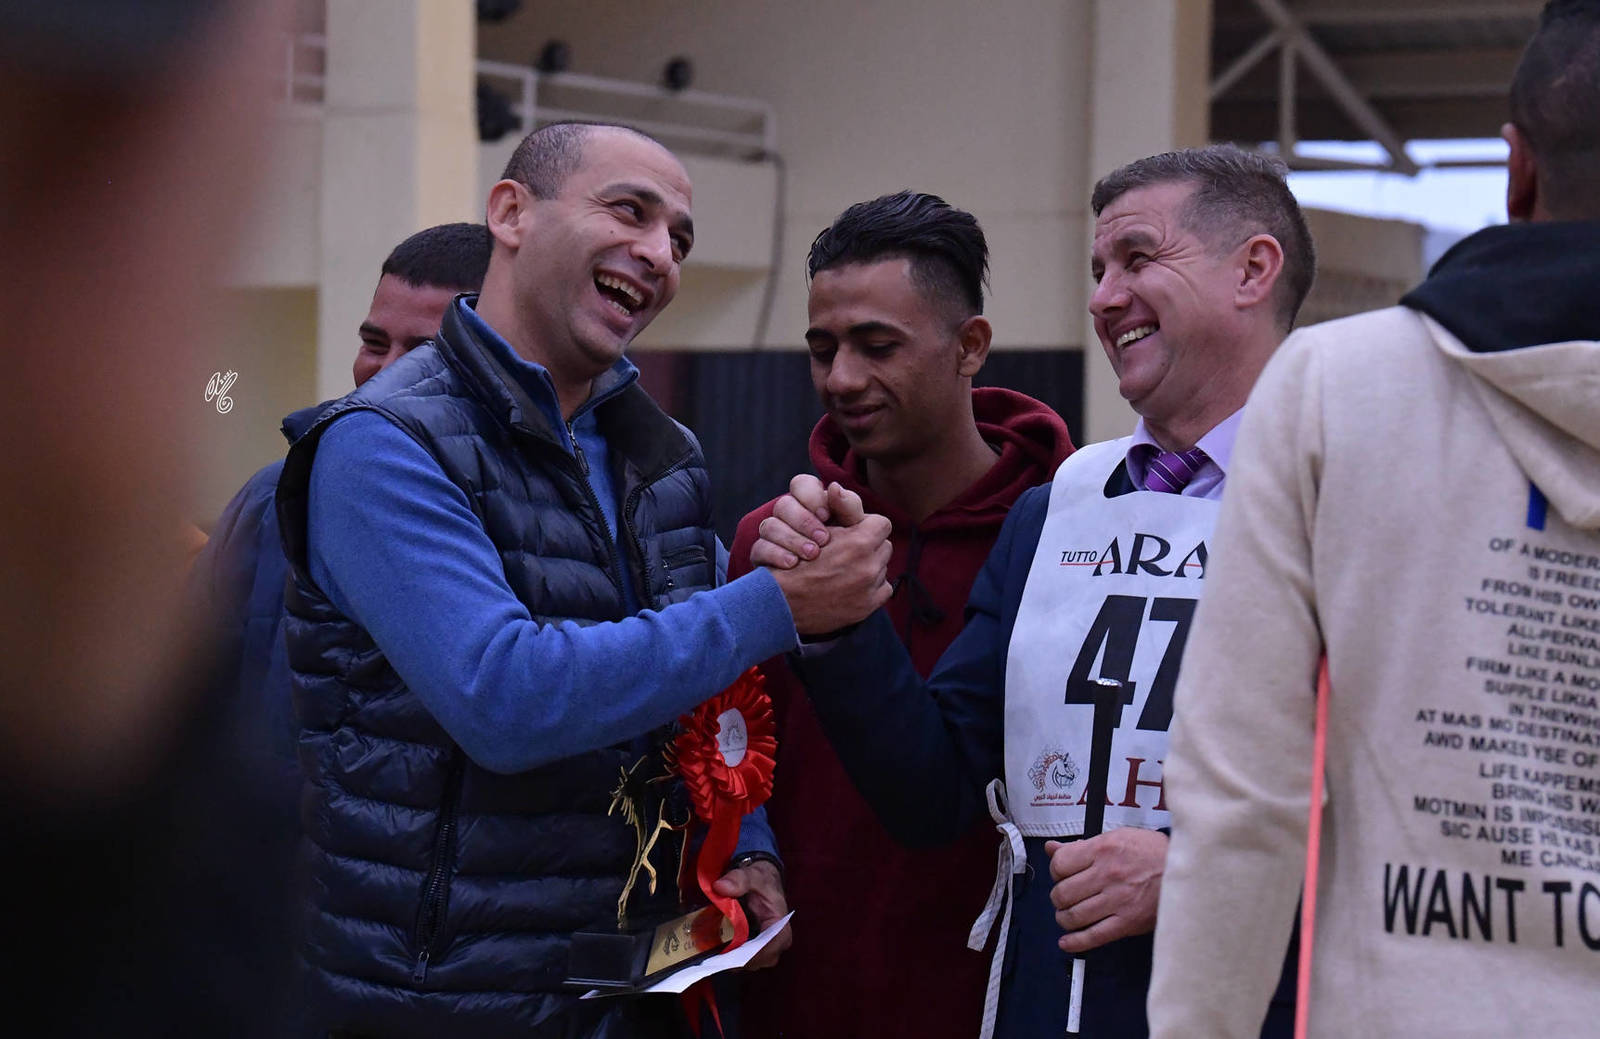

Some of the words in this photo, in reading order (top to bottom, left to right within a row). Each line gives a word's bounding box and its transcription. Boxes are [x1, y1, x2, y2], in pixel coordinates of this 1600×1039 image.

[1061, 551, 1098, 563] TUTTO
[1489, 538, 1515, 553] OF
[1520, 544, 1530, 555] A
[1534, 547, 1600, 570] MODER
[1065, 594, 1199, 732] 47
[1554, 671, 1565, 684] A
[1495, 806, 1514, 823] IS
[1501, 849, 1532, 867] ME
[1384, 862, 1525, 944] WANT
